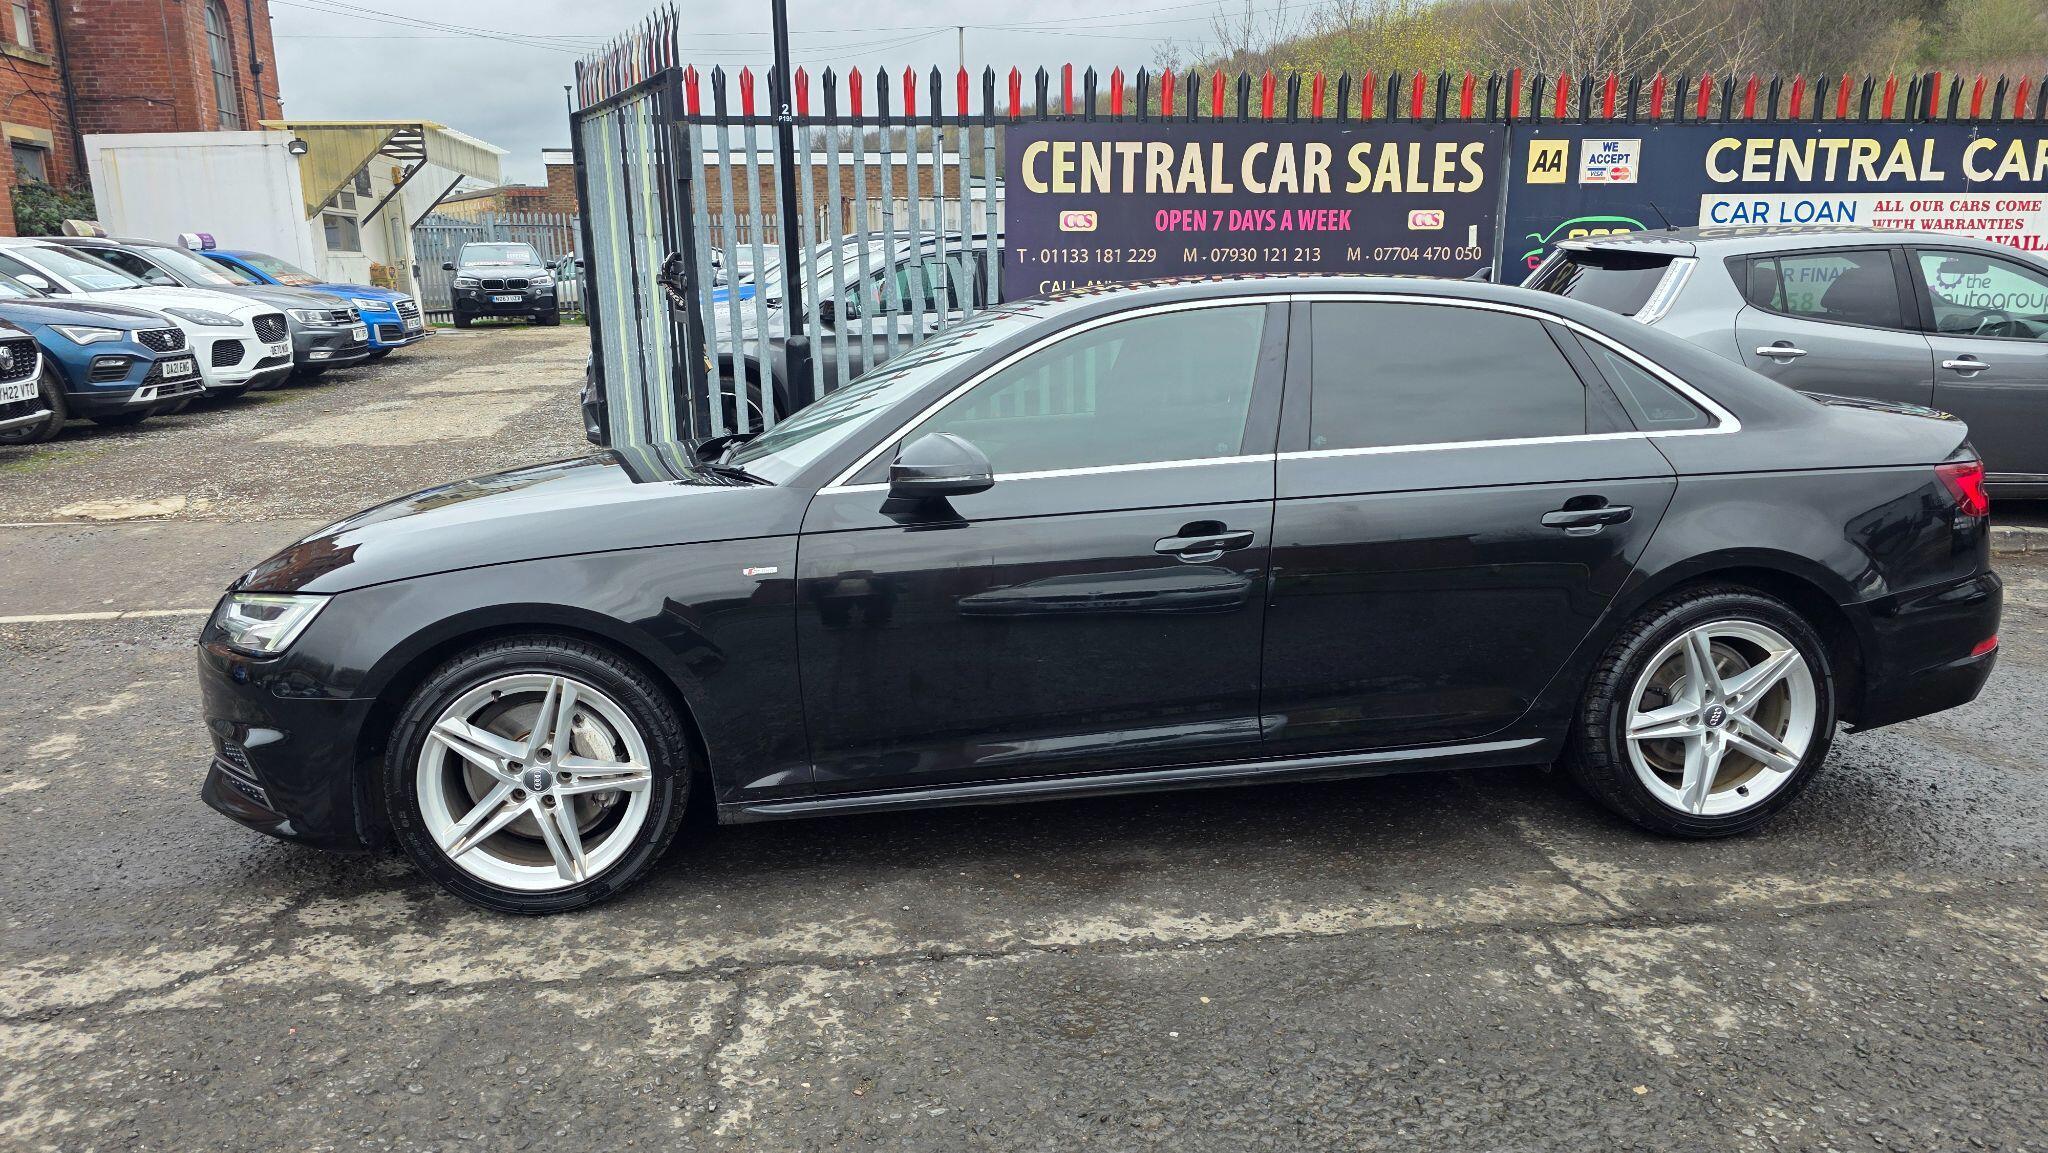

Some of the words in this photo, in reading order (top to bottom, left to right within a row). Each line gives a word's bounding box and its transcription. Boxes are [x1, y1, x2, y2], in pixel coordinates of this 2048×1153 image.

[781, 103, 790, 114] 2
[1602, 141, 1619, 153] WE
[1532, 149, 1563, 173] AA
[1588, 153, 1631, 165] ACCEPT
[1705, 137, 1946, 183] CENTRAL
[1021, 141, 1234, 194] CENTRAL
[1241, 141, 1333, 194] CAR
[1345, 141, 1485, 194] SALES
[1711, 201, 1769, 224] CAR
[1779, 201, 1858, 224] LOAN
[1873, 200, 1905, 212] ALL
[1909, 200, 1945, 212] OUR
[1950, 200, 1991, 212] CARS
[1995, 200, 2043, 212] COME
[1155, 209, 1207, 232] OPEN
[1212, 210, 1224, 231] 7
[1229, 209, 1276, 232] DAYS
[1280, 209, 1293, 231] A
[1297, 209, 1353, 231] WEEK
[1872, 218, 1915, 230] WITH
[1920, 218, 2025, 230] WARRANTIES
[1040, 248, 1089, 264] 01133
[1095, 248, 1121, 263] 181
[1127, 248, 1157, 263] 229
[1210, 247, 1257, 263] 07930
[1263, 247, 1288, 262] 121
[1293, 247, 1321, 262] 213
[1374, 246, 1420, 262] 07704
[1424, 246, 1451, 261] 470
[1455, 246, 1482, 261] 050
[1966, 272, 1992, 289] the
[20, 382, 35, 397] VTO
